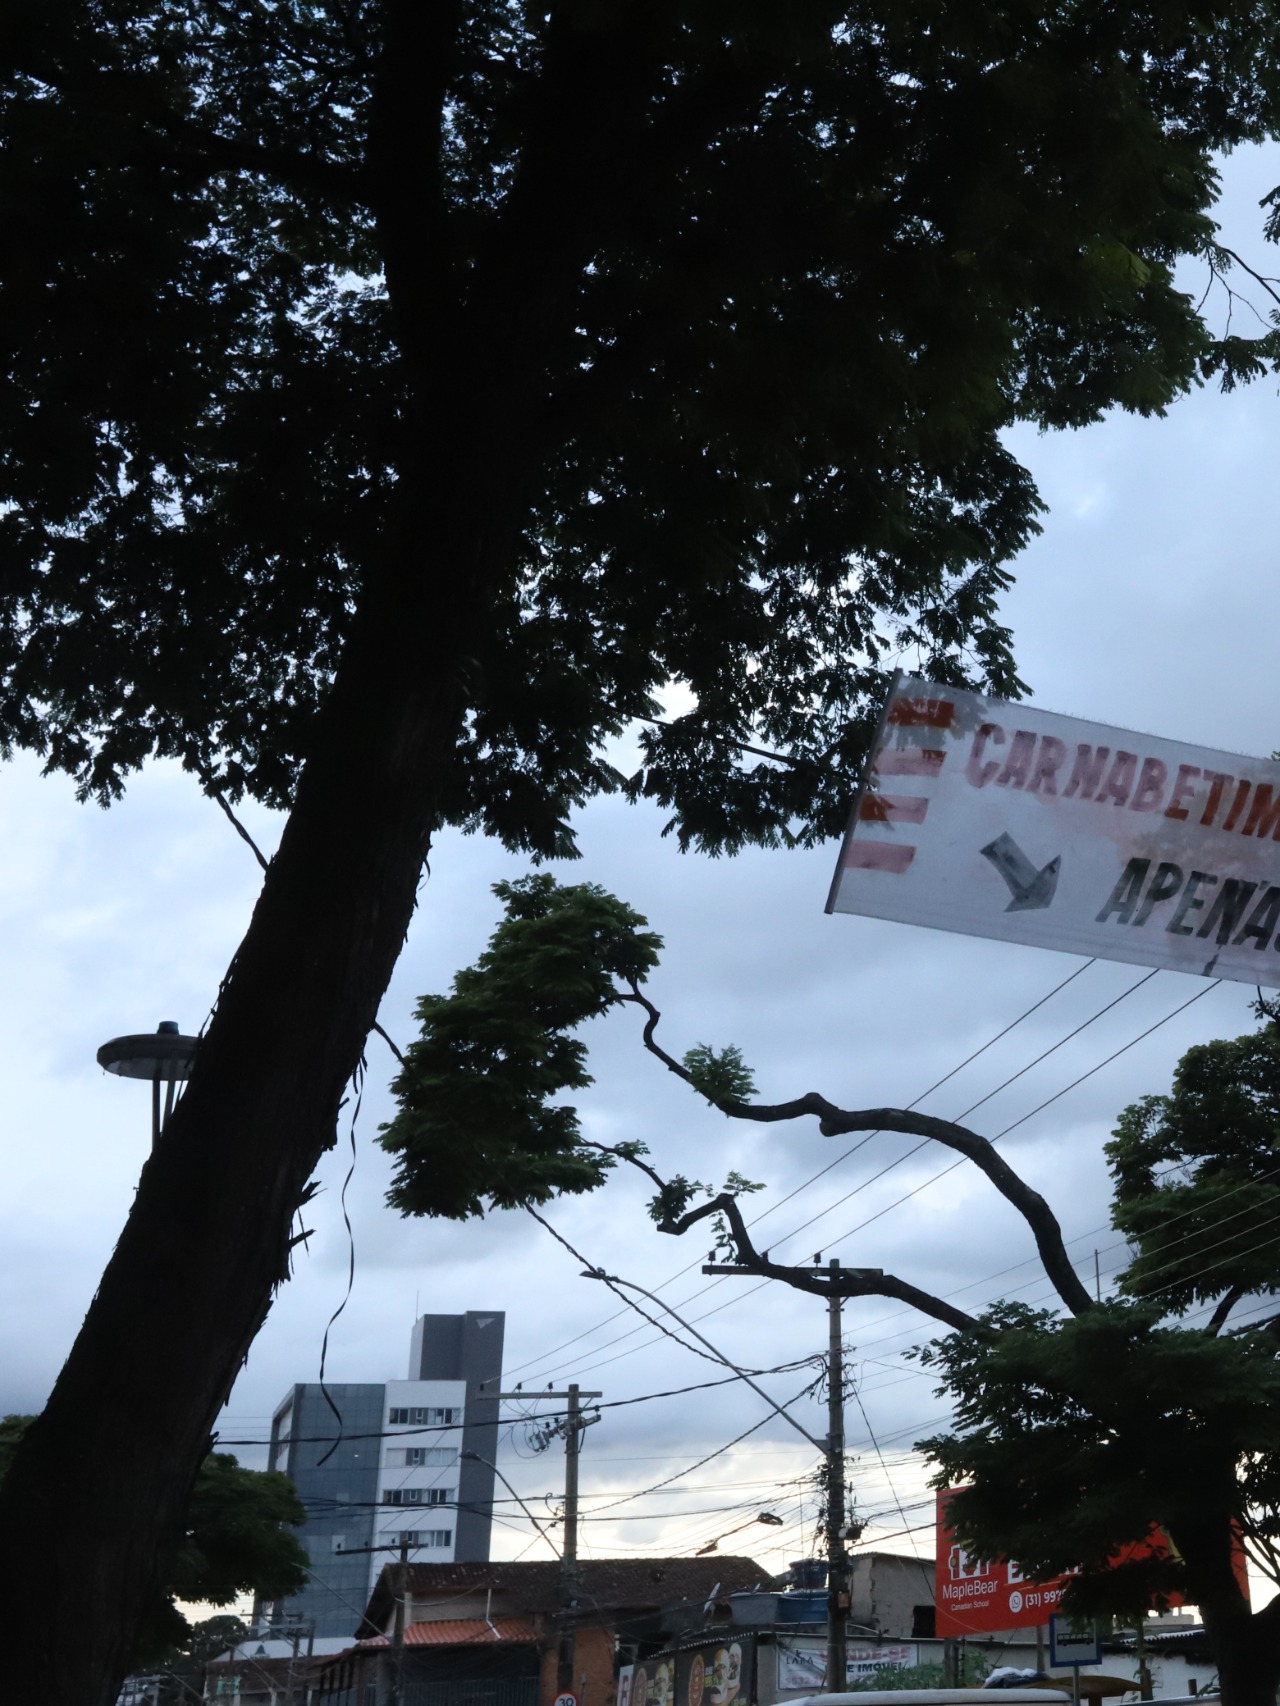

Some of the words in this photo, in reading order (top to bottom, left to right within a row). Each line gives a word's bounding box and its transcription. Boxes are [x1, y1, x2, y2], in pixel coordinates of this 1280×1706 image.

[943, 1580, 998, 1600] MapleBear
[951, 1602, 972, 1612] Canadian
[973, 1599, 989, 1608] School
[1025, 1592, 1041, 1609] (31)
